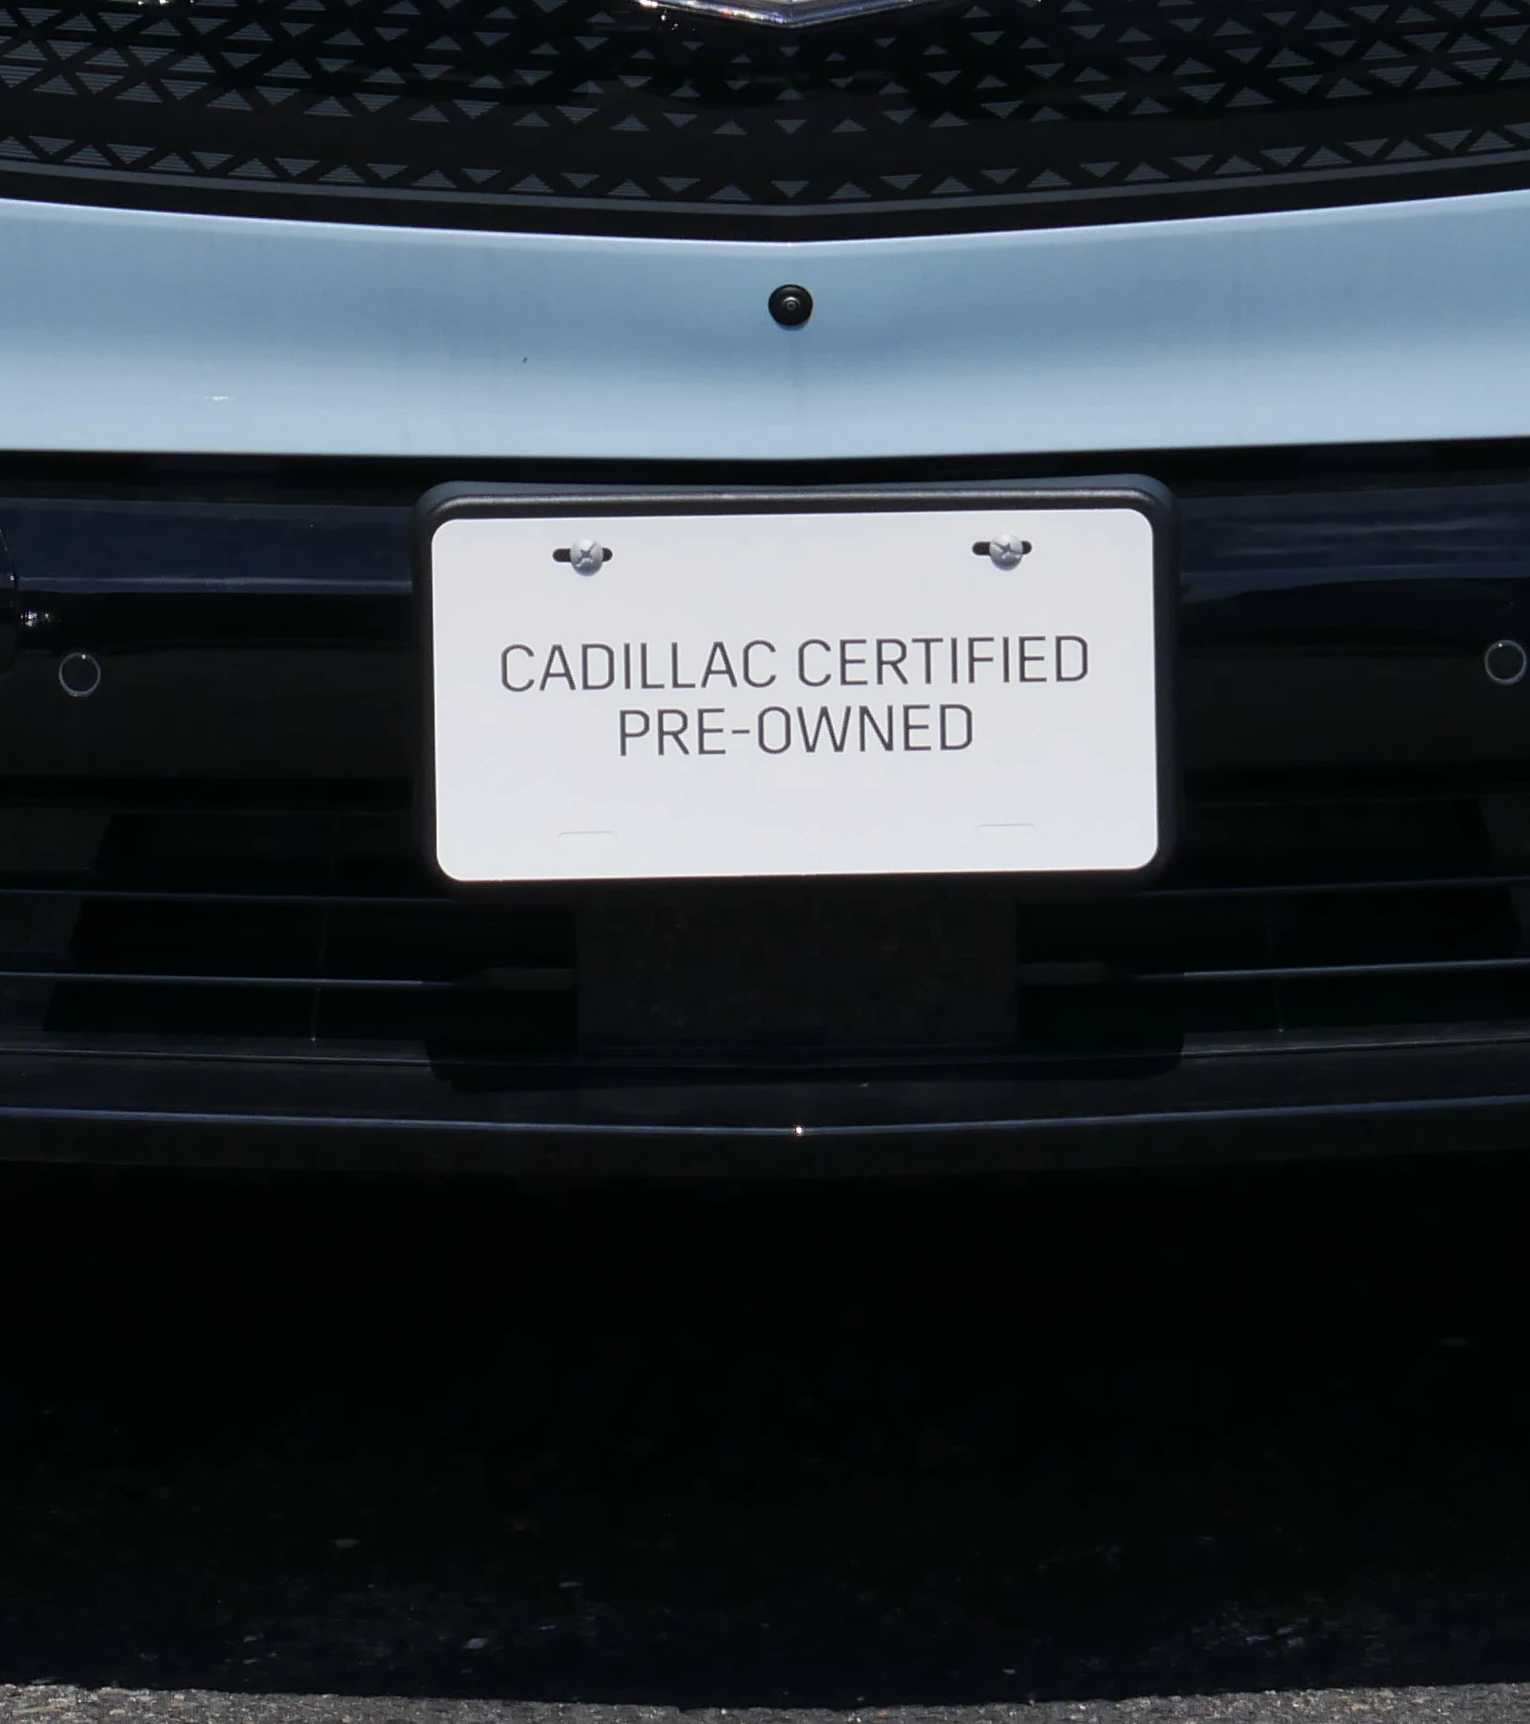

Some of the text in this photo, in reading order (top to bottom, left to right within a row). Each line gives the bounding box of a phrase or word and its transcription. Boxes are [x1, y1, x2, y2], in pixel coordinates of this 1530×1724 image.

[501, 635, 1088, 693] CADILLAC CERTIFIED
[619, 704, 973, 757] PRE-OWNED
